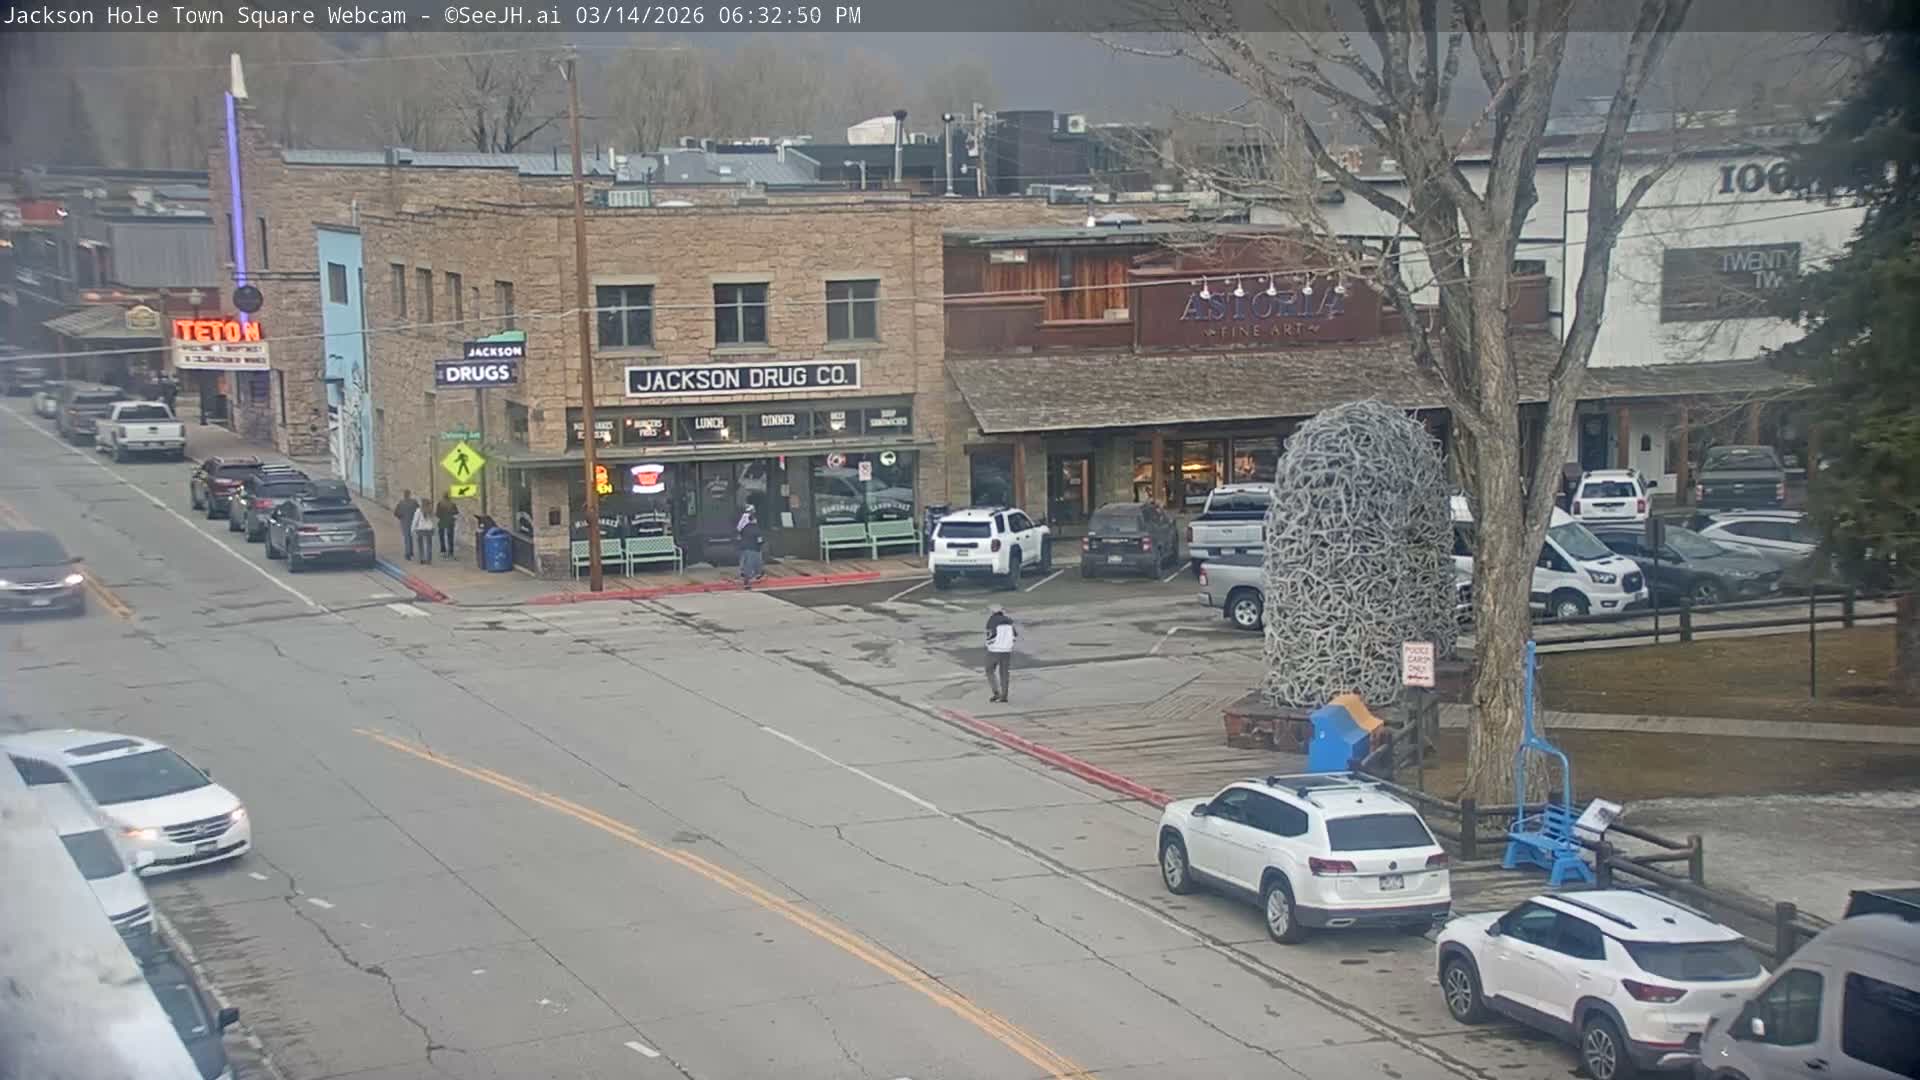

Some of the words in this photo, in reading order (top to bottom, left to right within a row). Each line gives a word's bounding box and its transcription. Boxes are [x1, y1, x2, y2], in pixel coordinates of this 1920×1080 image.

[1721, 250, 1798, 272] TWENTY
[1752, 271, 1784, 289] TW
[1180, 286, 1345, 321] ASTORIA
[176, 320, 261, 342] TETON
[1221, 325, 1261, 337] FINE
[1271, 322, 1303, 336] ART
[468, 346, 523, 357] JACKSON
[446, 365, 510, 382] DRUGS
[637, 369, 740, 392] JACKSON
[750, 367, 808, 387] DRUG
[816, 365, 849, 385] CO.
[695, 417, 725, 430] LUNCH
[761, 413, 796, 427] DINNER
